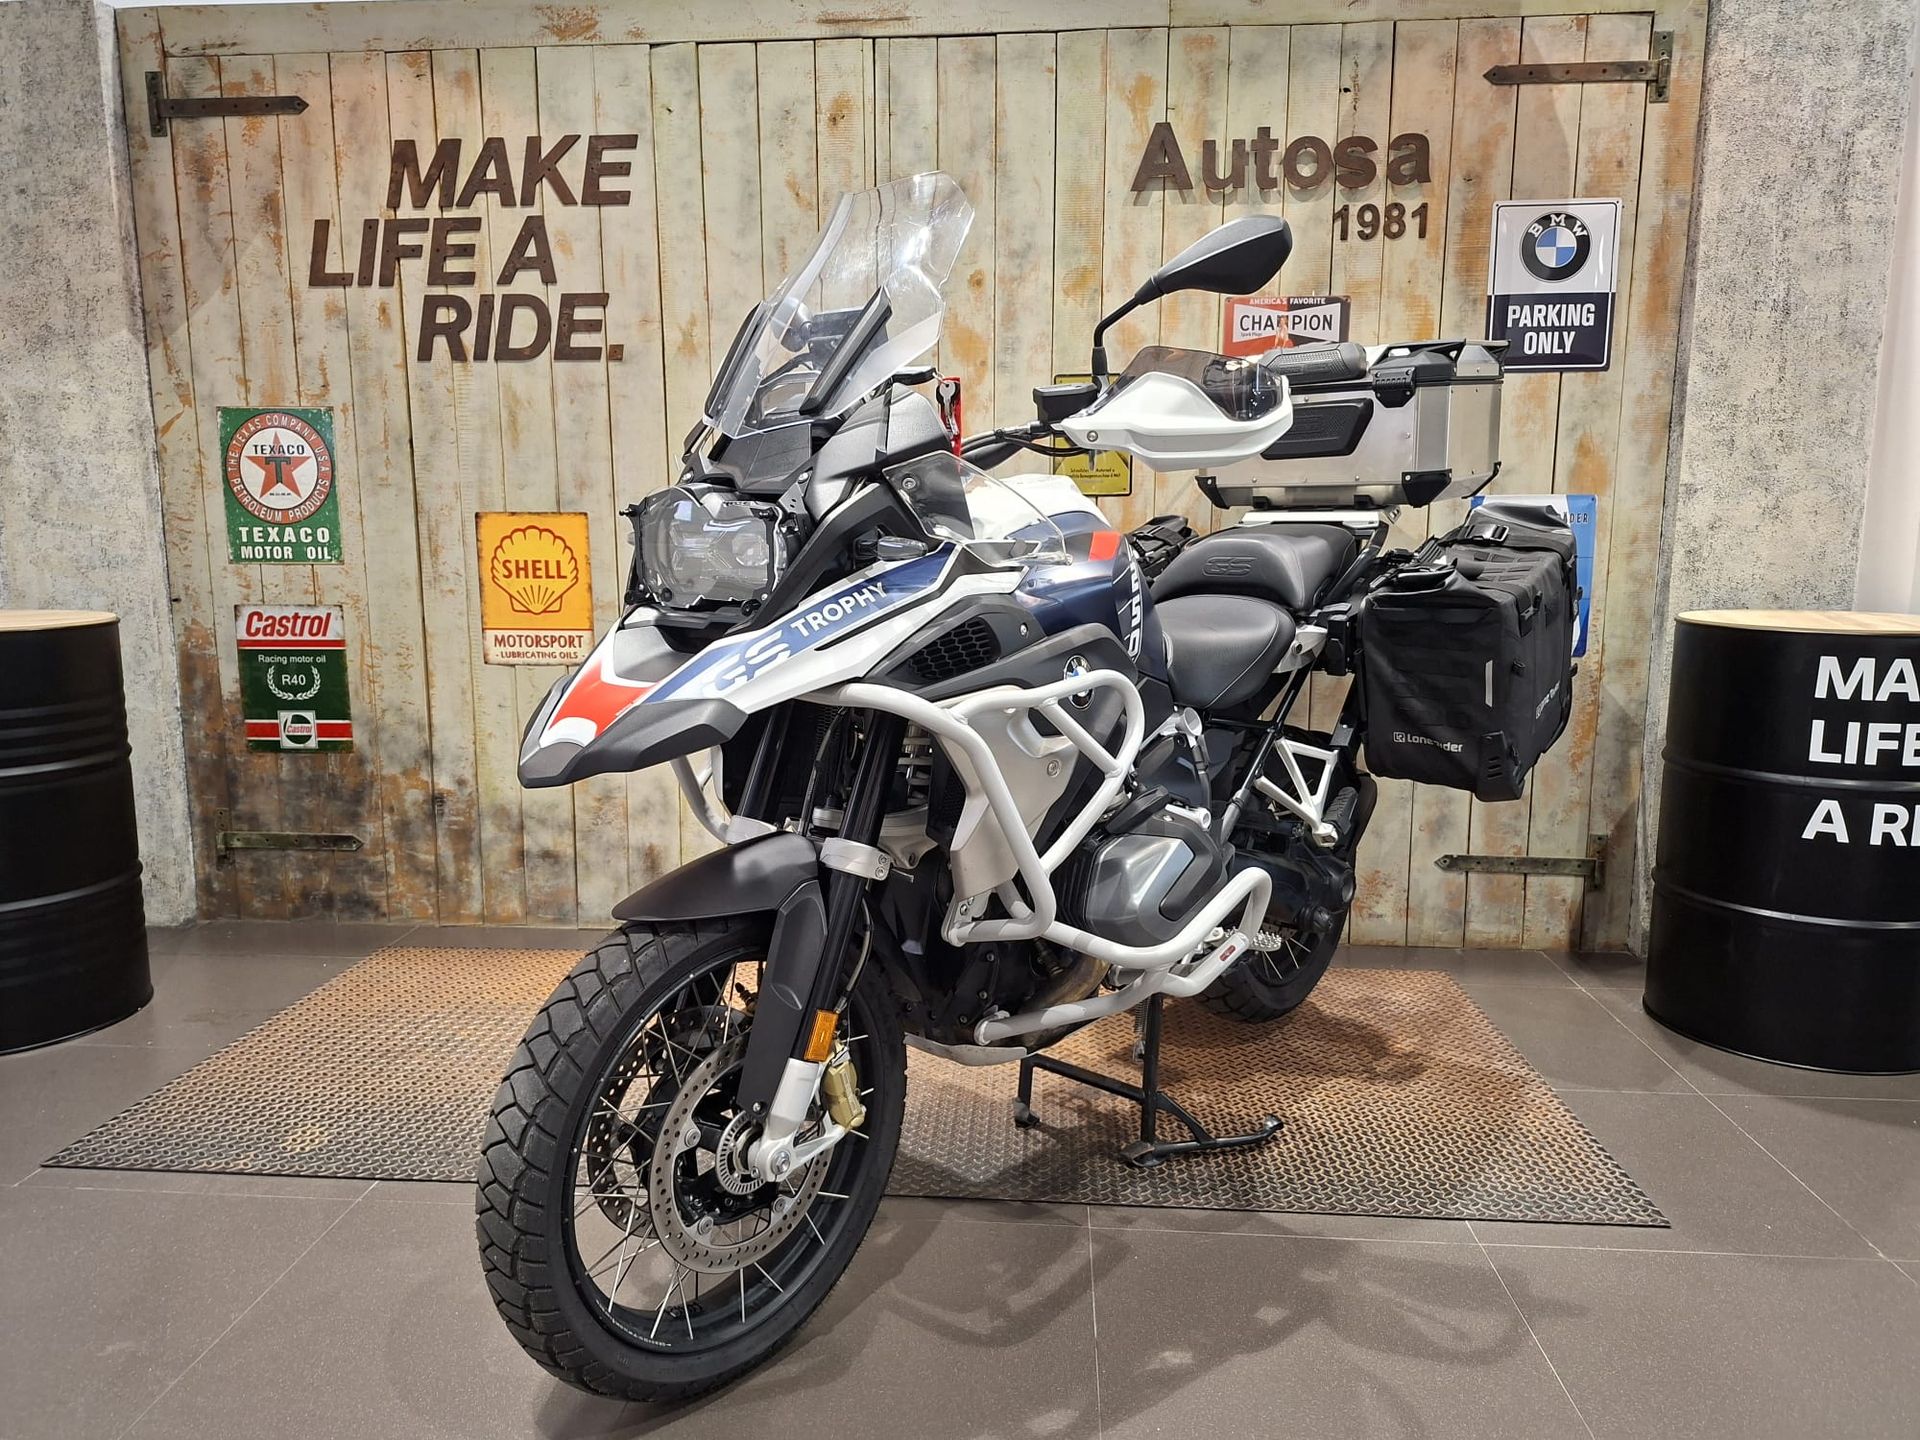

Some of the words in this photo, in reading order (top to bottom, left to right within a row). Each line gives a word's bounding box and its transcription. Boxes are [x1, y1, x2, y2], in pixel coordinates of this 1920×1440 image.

[1131, 122, 1431, 191] Autosa
[386, 134, 639, 208] MAKE
[1334, 202, 1428, 240] 1981
[1528, 213, 1588, 238] BMW
[308, 217, 482, 287] LIFE
[496, 215, 557, 285] A
[417, 293, 624, 361] RIDE.
[1507, 303, 1595, 328] PARKING
[1523, 331, 1576, 355] ONLY
[233, 418, 262, 448] TEXAS
[266, 415, 317, 441] COMPANY
[228, 452, 239, 472] THE
[253, 444, 305, 456] TEXACO
[265, 457, 292, 484] T
[231, 478, 283, 522] PETROLEUM
[289, 478, 330, 521] PRODUCTS
[239, 527, 330, 543] TEXACO
[240, 546, 293, 560] MOTOR
[307, 546, 332, 560] OIL
[502, 559, 568, 579] SHELL
[791, 582, 888, 638] TROPHY
[245, 611, 332, 637] Castrol
[494, 634, 584, 648] MOTORSPORT
[258, 655, 287, 664] Racing
[290, 655, 313, 663] motor
[315, 655, 326, 663] oil
[500, 651, 557, 659] LUBRICATING
[559, 651, 578, 659] OILS
[281, 674, 306, 686] R40
[1814, 656, 1920, 702] MA
[286, 724, 313, 734] Castrol
[1808, 719, 1920, 767] LIFE
[1801, 799, 1850, 844] A
